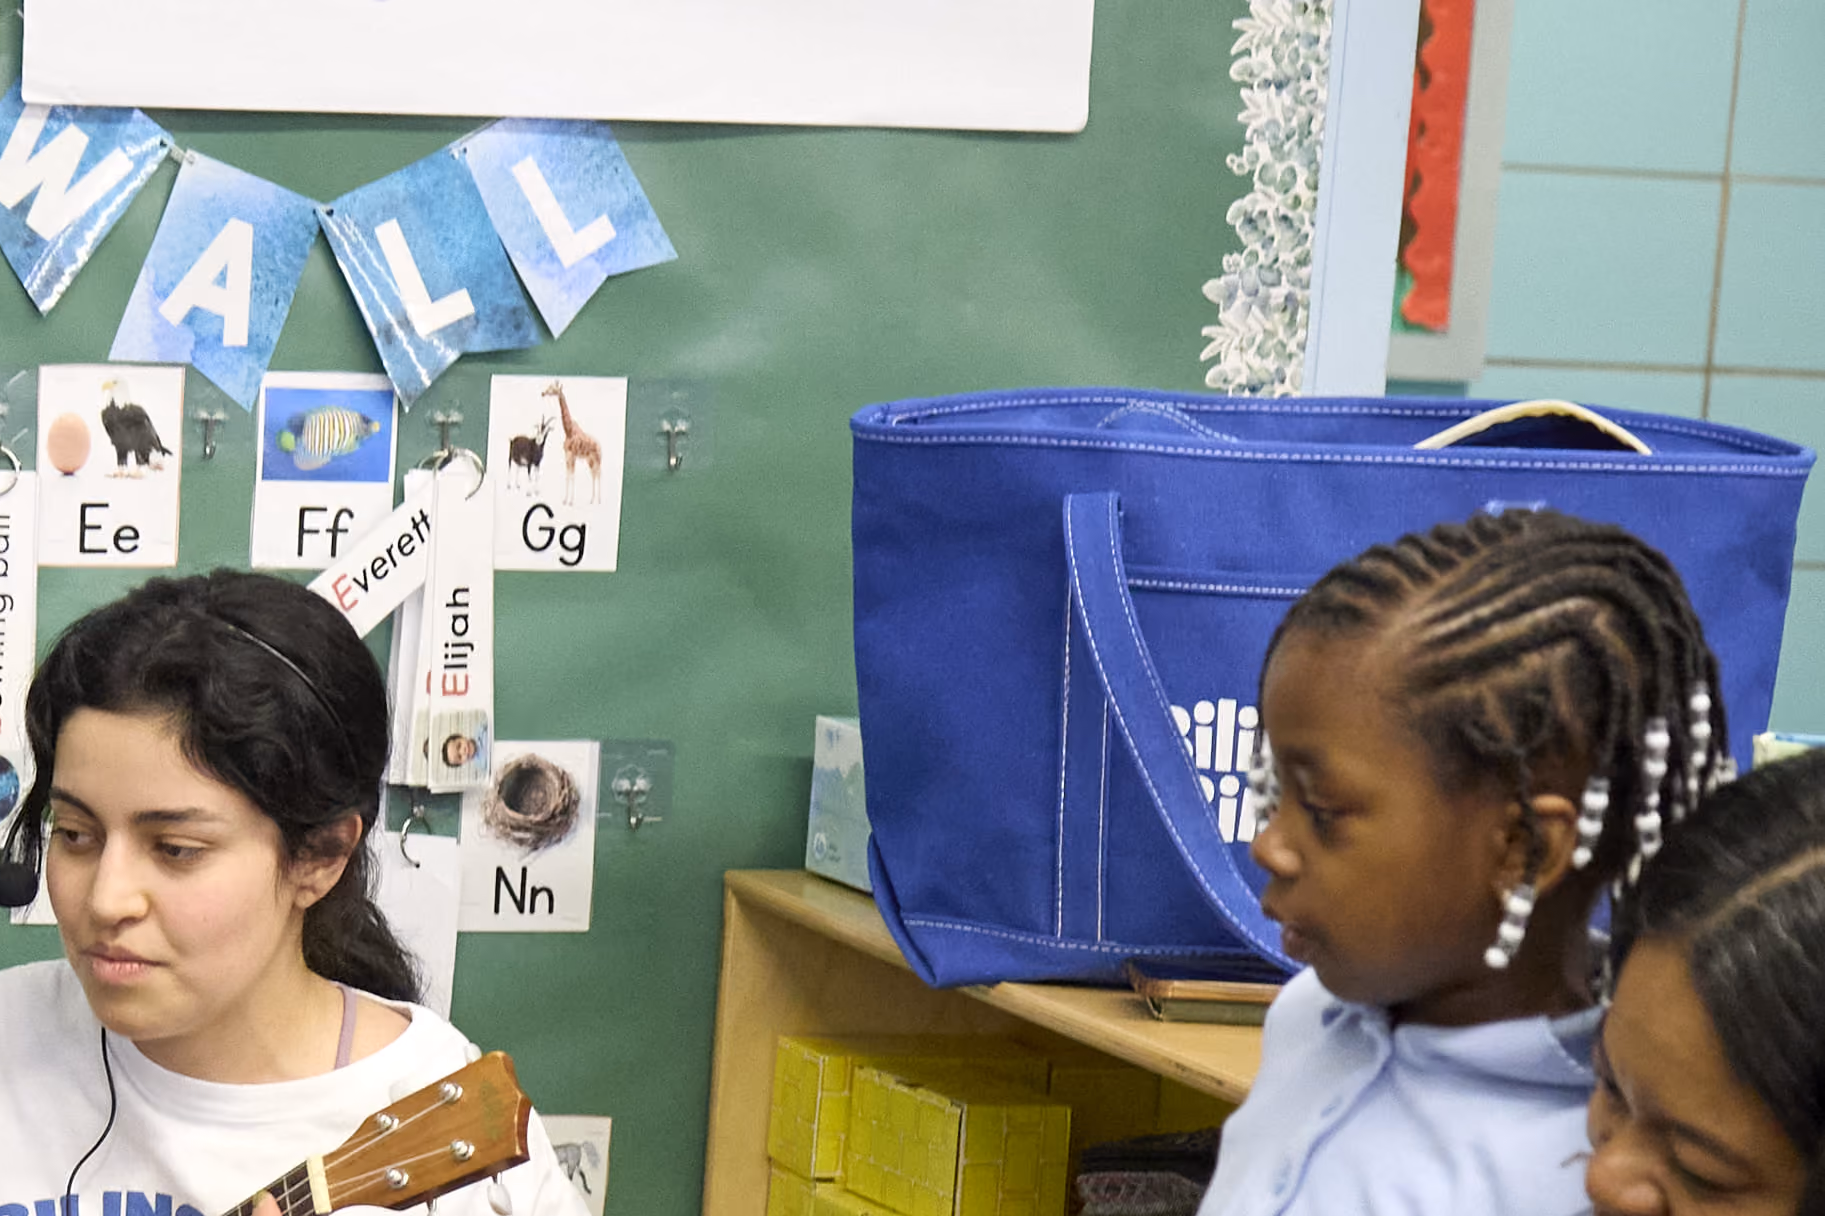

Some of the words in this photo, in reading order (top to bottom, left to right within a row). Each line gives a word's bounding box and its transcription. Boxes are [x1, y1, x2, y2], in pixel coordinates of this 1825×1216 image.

[79, 502, 140, 554] Ee
[297, 506, 354, 558] Ff
[522, 503, 587, 567] Gg
[331, 508, 431, 613] Everett
[441, 586, 475, 698] Elijah
[493, 866, 555, 915] Nn
